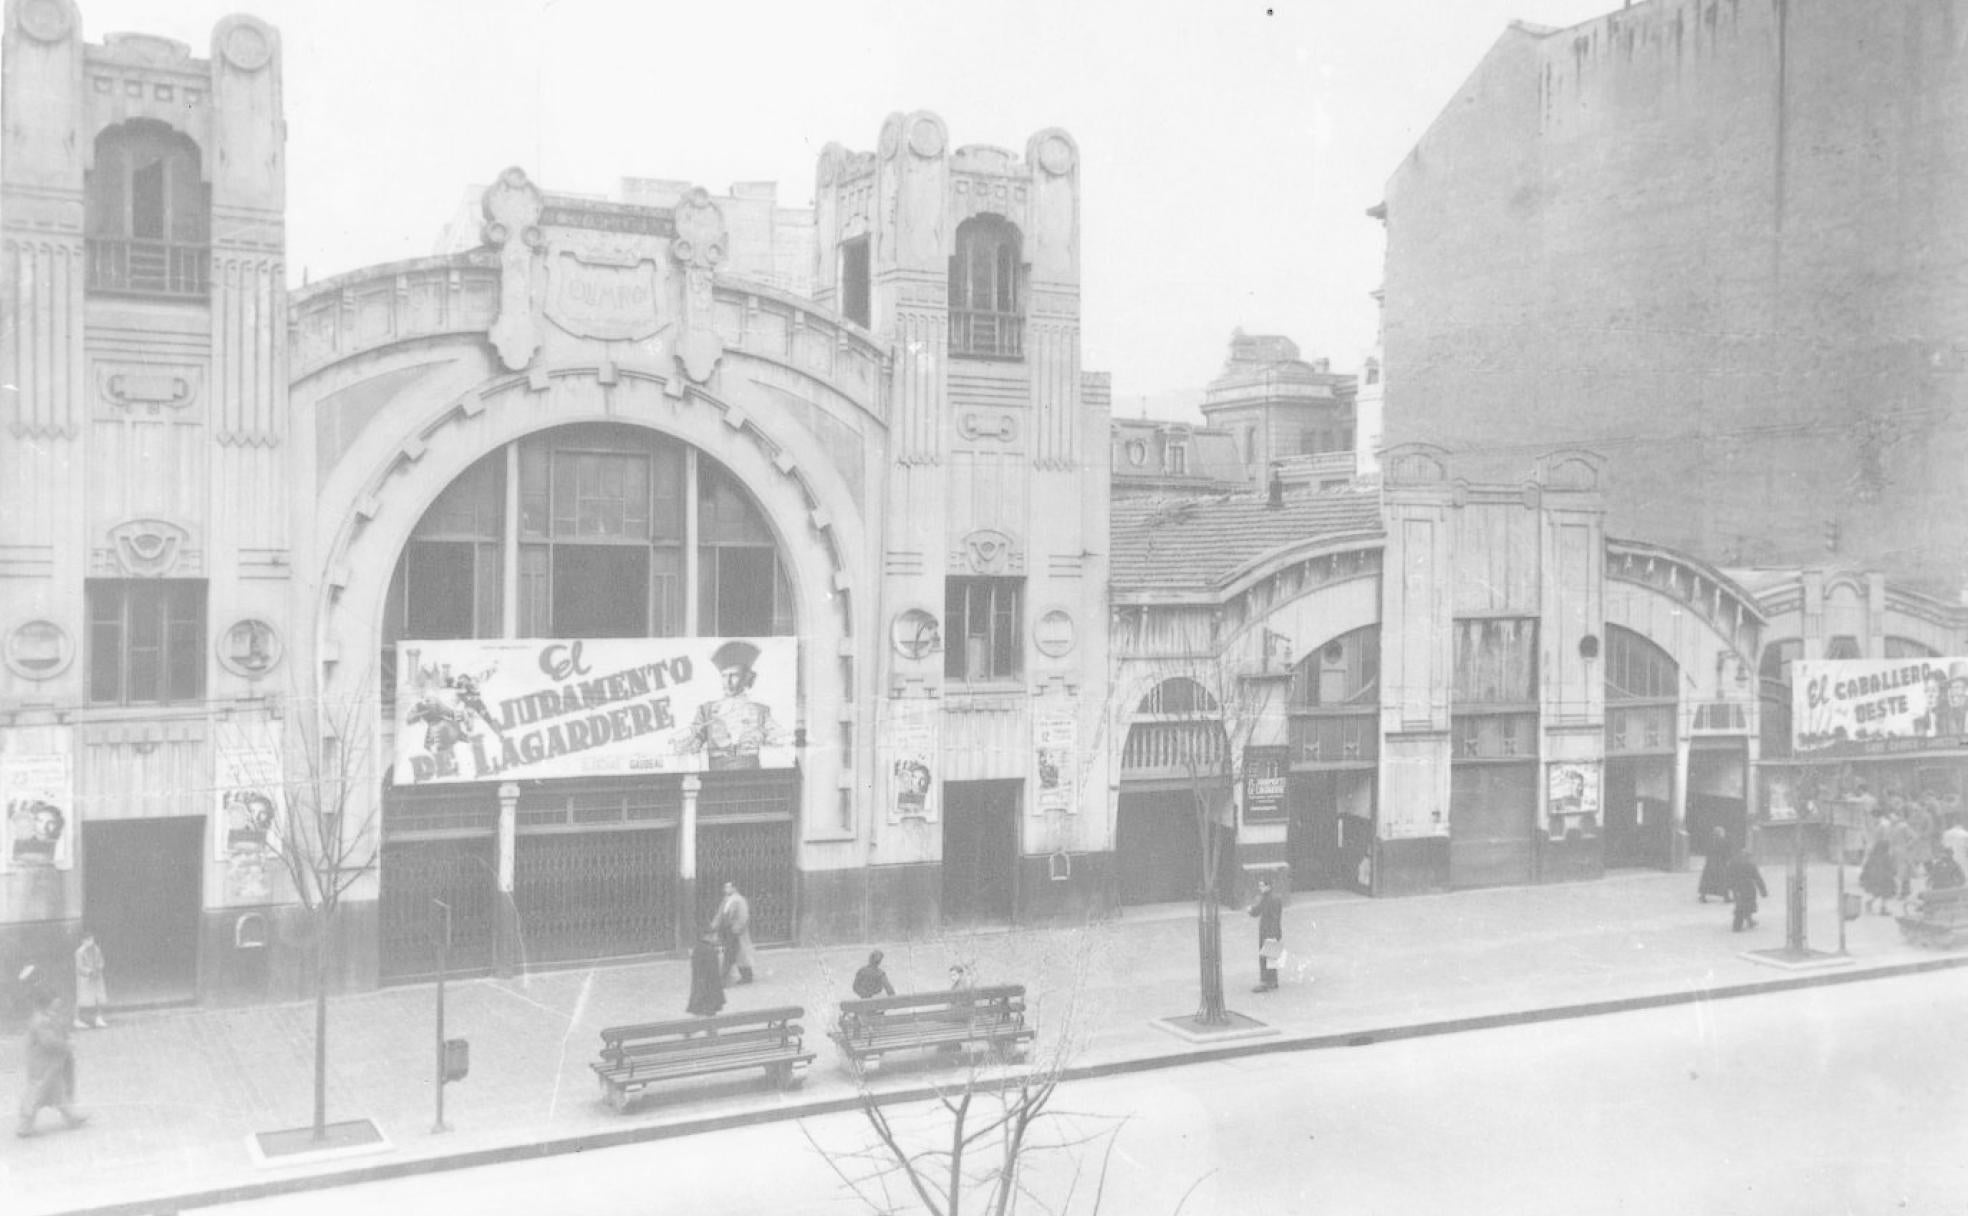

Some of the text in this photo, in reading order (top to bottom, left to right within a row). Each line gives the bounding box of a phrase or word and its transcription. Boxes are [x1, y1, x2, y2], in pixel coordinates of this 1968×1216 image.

[539, 640, 592, 681] El
[499, 655, 693, 731] JURAMENTO
[1807, 662, 1930, 709] El CABALLERO
[1854, 695, 1909, 724] OESTE
[409, 696, 675, 781] DE LAGARDERE
